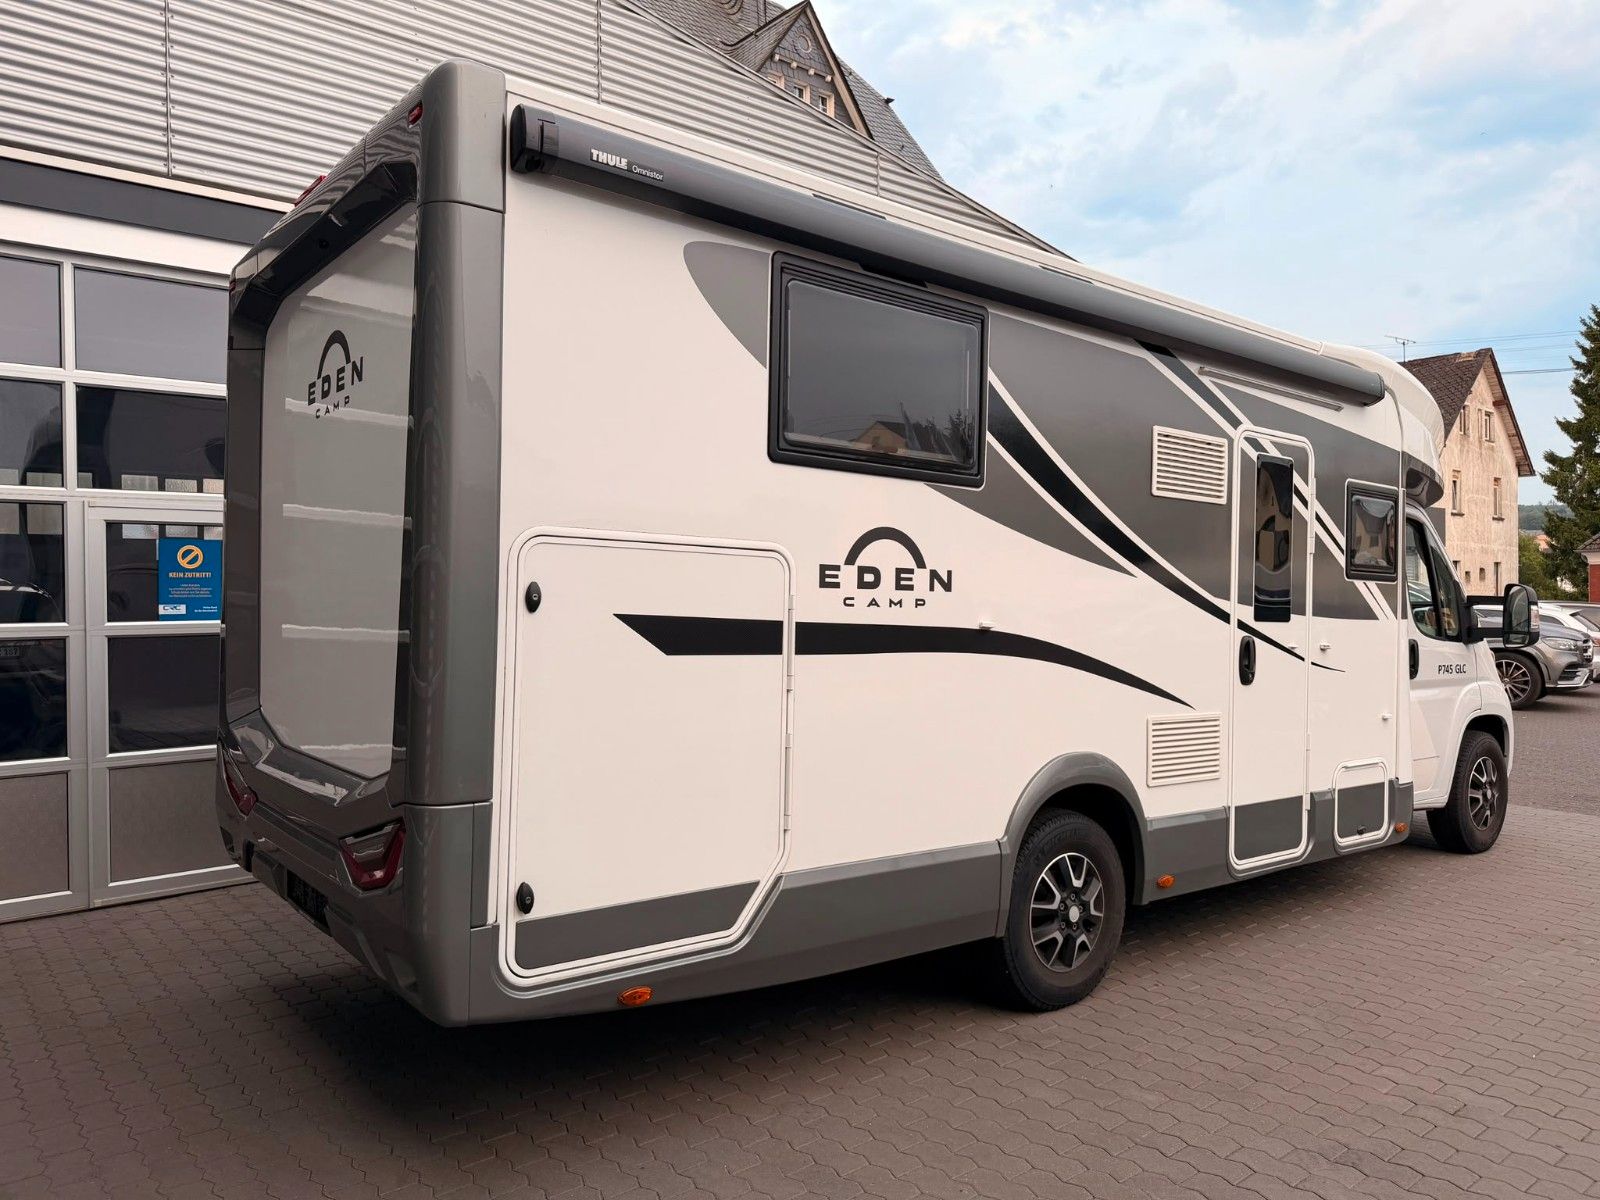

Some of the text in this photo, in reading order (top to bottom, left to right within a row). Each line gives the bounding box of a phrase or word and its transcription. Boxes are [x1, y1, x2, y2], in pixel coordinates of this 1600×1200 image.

[591, 148, 664, 181] THULE Omnistor
[308, 356, 364, 406] EDEN
[315, 395, 350, 419] CAMP
[818, 563, 953, 593] EDEN
[842, 596, 926, 609] CAMP
[1437, 663, 1467, 675] P745 GLC
